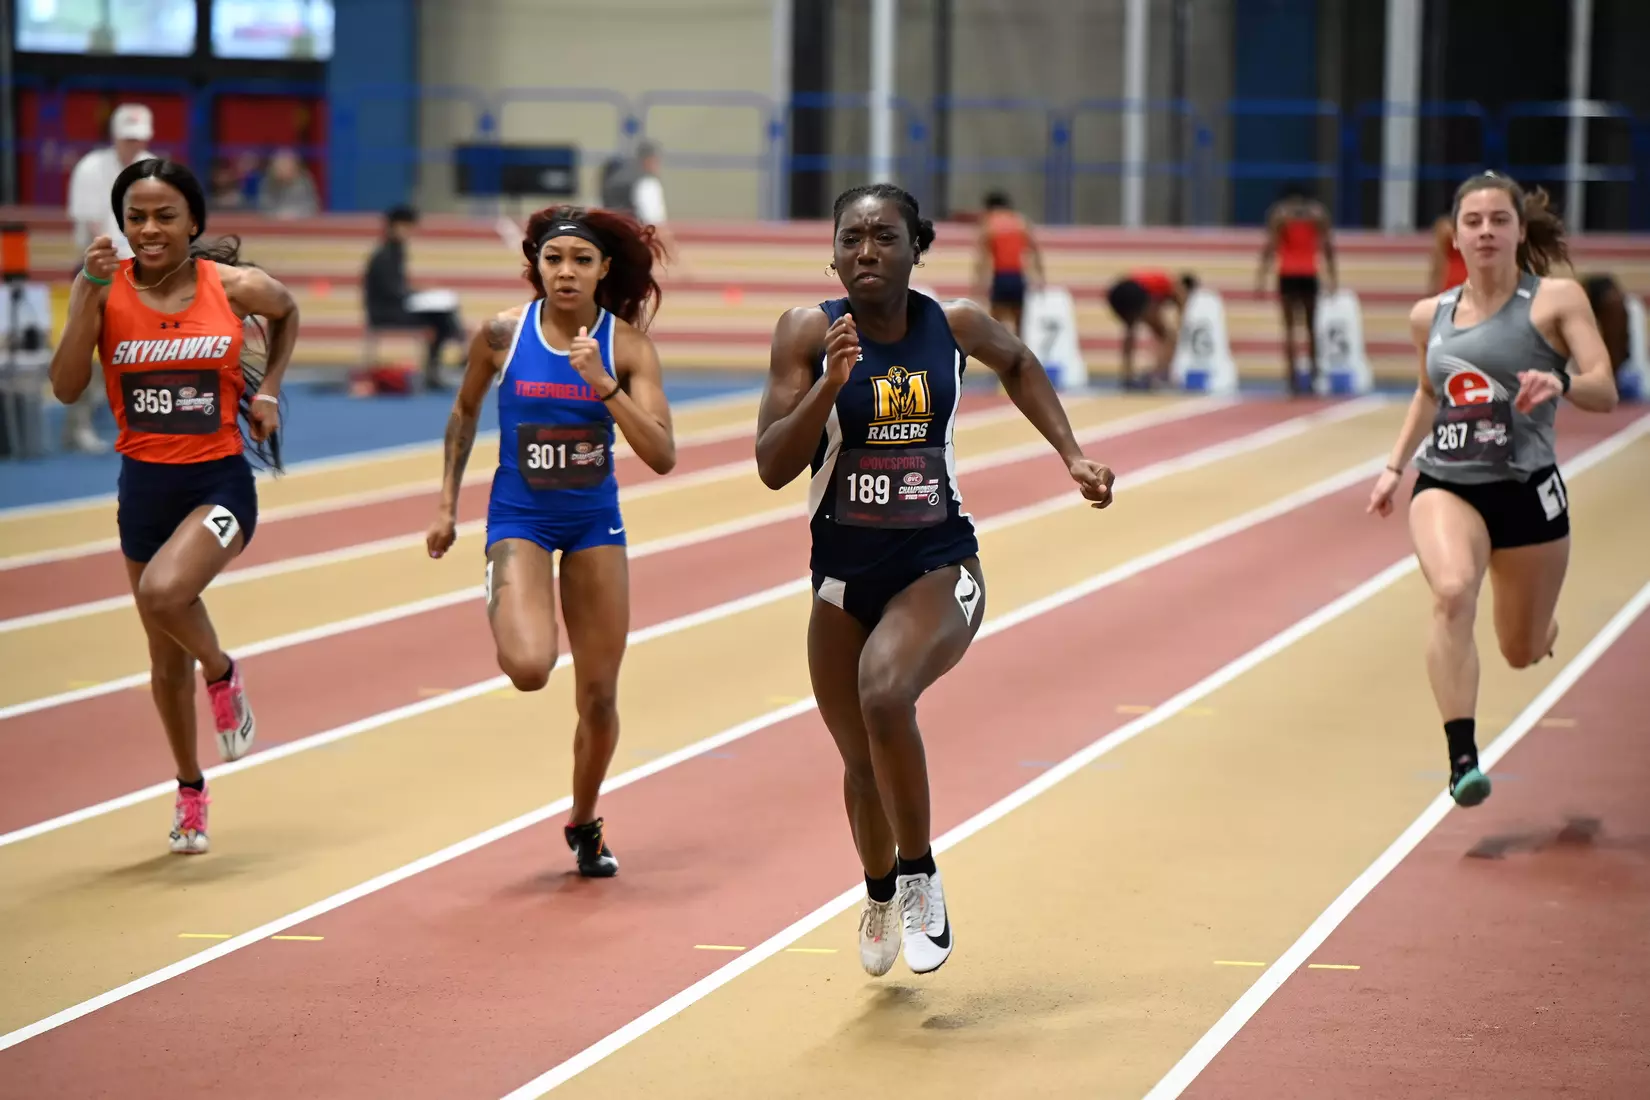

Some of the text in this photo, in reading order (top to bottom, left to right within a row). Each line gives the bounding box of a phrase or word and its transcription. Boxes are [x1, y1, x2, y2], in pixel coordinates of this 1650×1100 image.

[1041, 319, 1063, 350] 7
[1191, 326, 1215, 356] 6
[111, 336, 232, 365] SKYHAWKS
[132, 388, 172, 414] 359
[867, 423, 929, 440] RACERS
[1437, 422, 1468, 450] 267
[526, 443, 566, 470] 301
[847, 473, 890, 505] 189
[212, 515, 234, 538] 4
